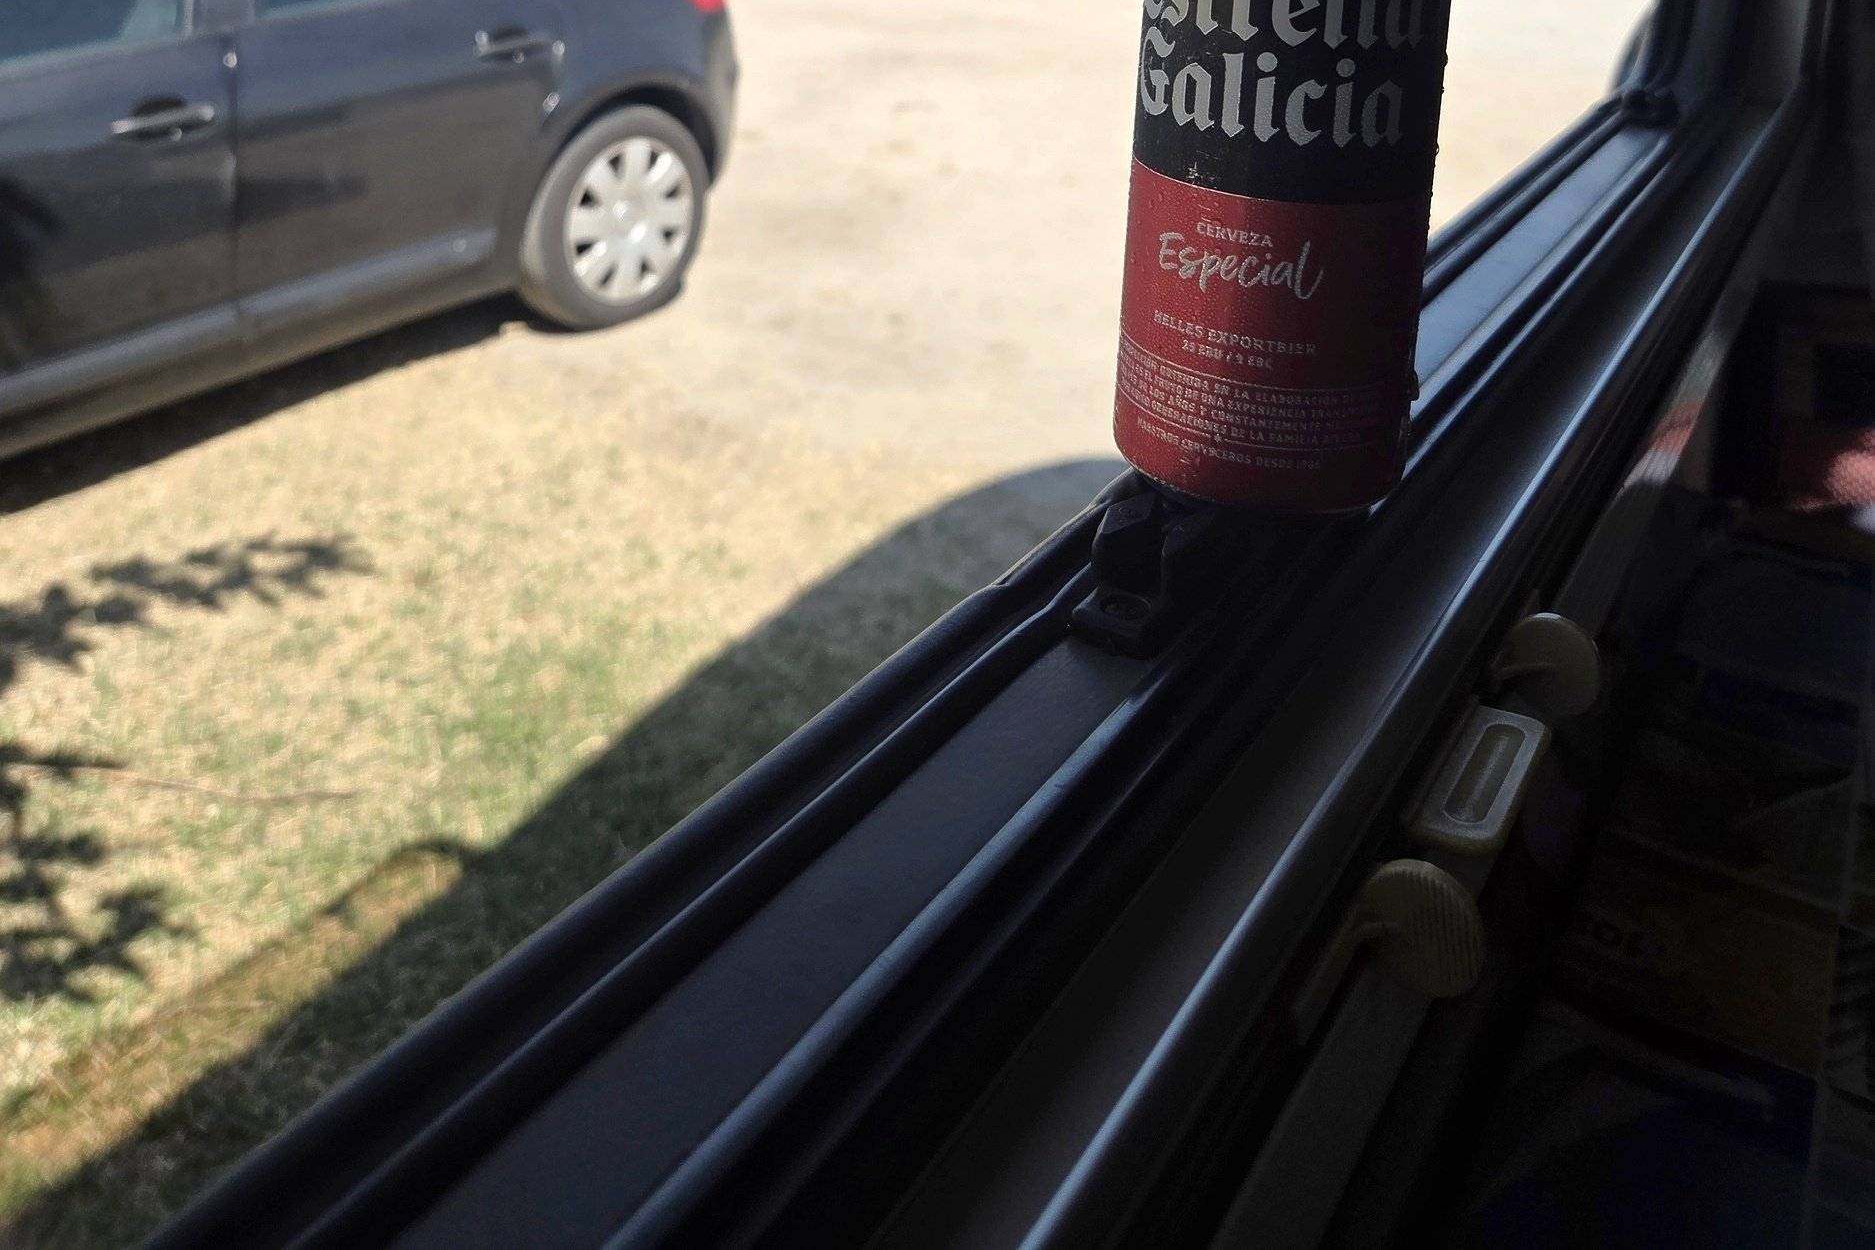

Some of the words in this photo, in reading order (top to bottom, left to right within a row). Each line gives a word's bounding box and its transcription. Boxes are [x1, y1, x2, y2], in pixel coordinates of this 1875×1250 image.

[1140, 26, 1404, 149] Galicia
[1196, 221, 1274, 248] CERVEZA
[1158, 231, 1324, 300] Especial
[1153, 309, 1204, 338] HELLES
[1200, 393, 1225, 408] UNA
[1234, 388, 1250, 400] LA
[1230, 426, 1246, 439] DE
[1249, 430, 1265, 441] LA
[1181, 438, 1252, 464] CERVECEROS
[1255, 456, 1294, 469] DESDE
